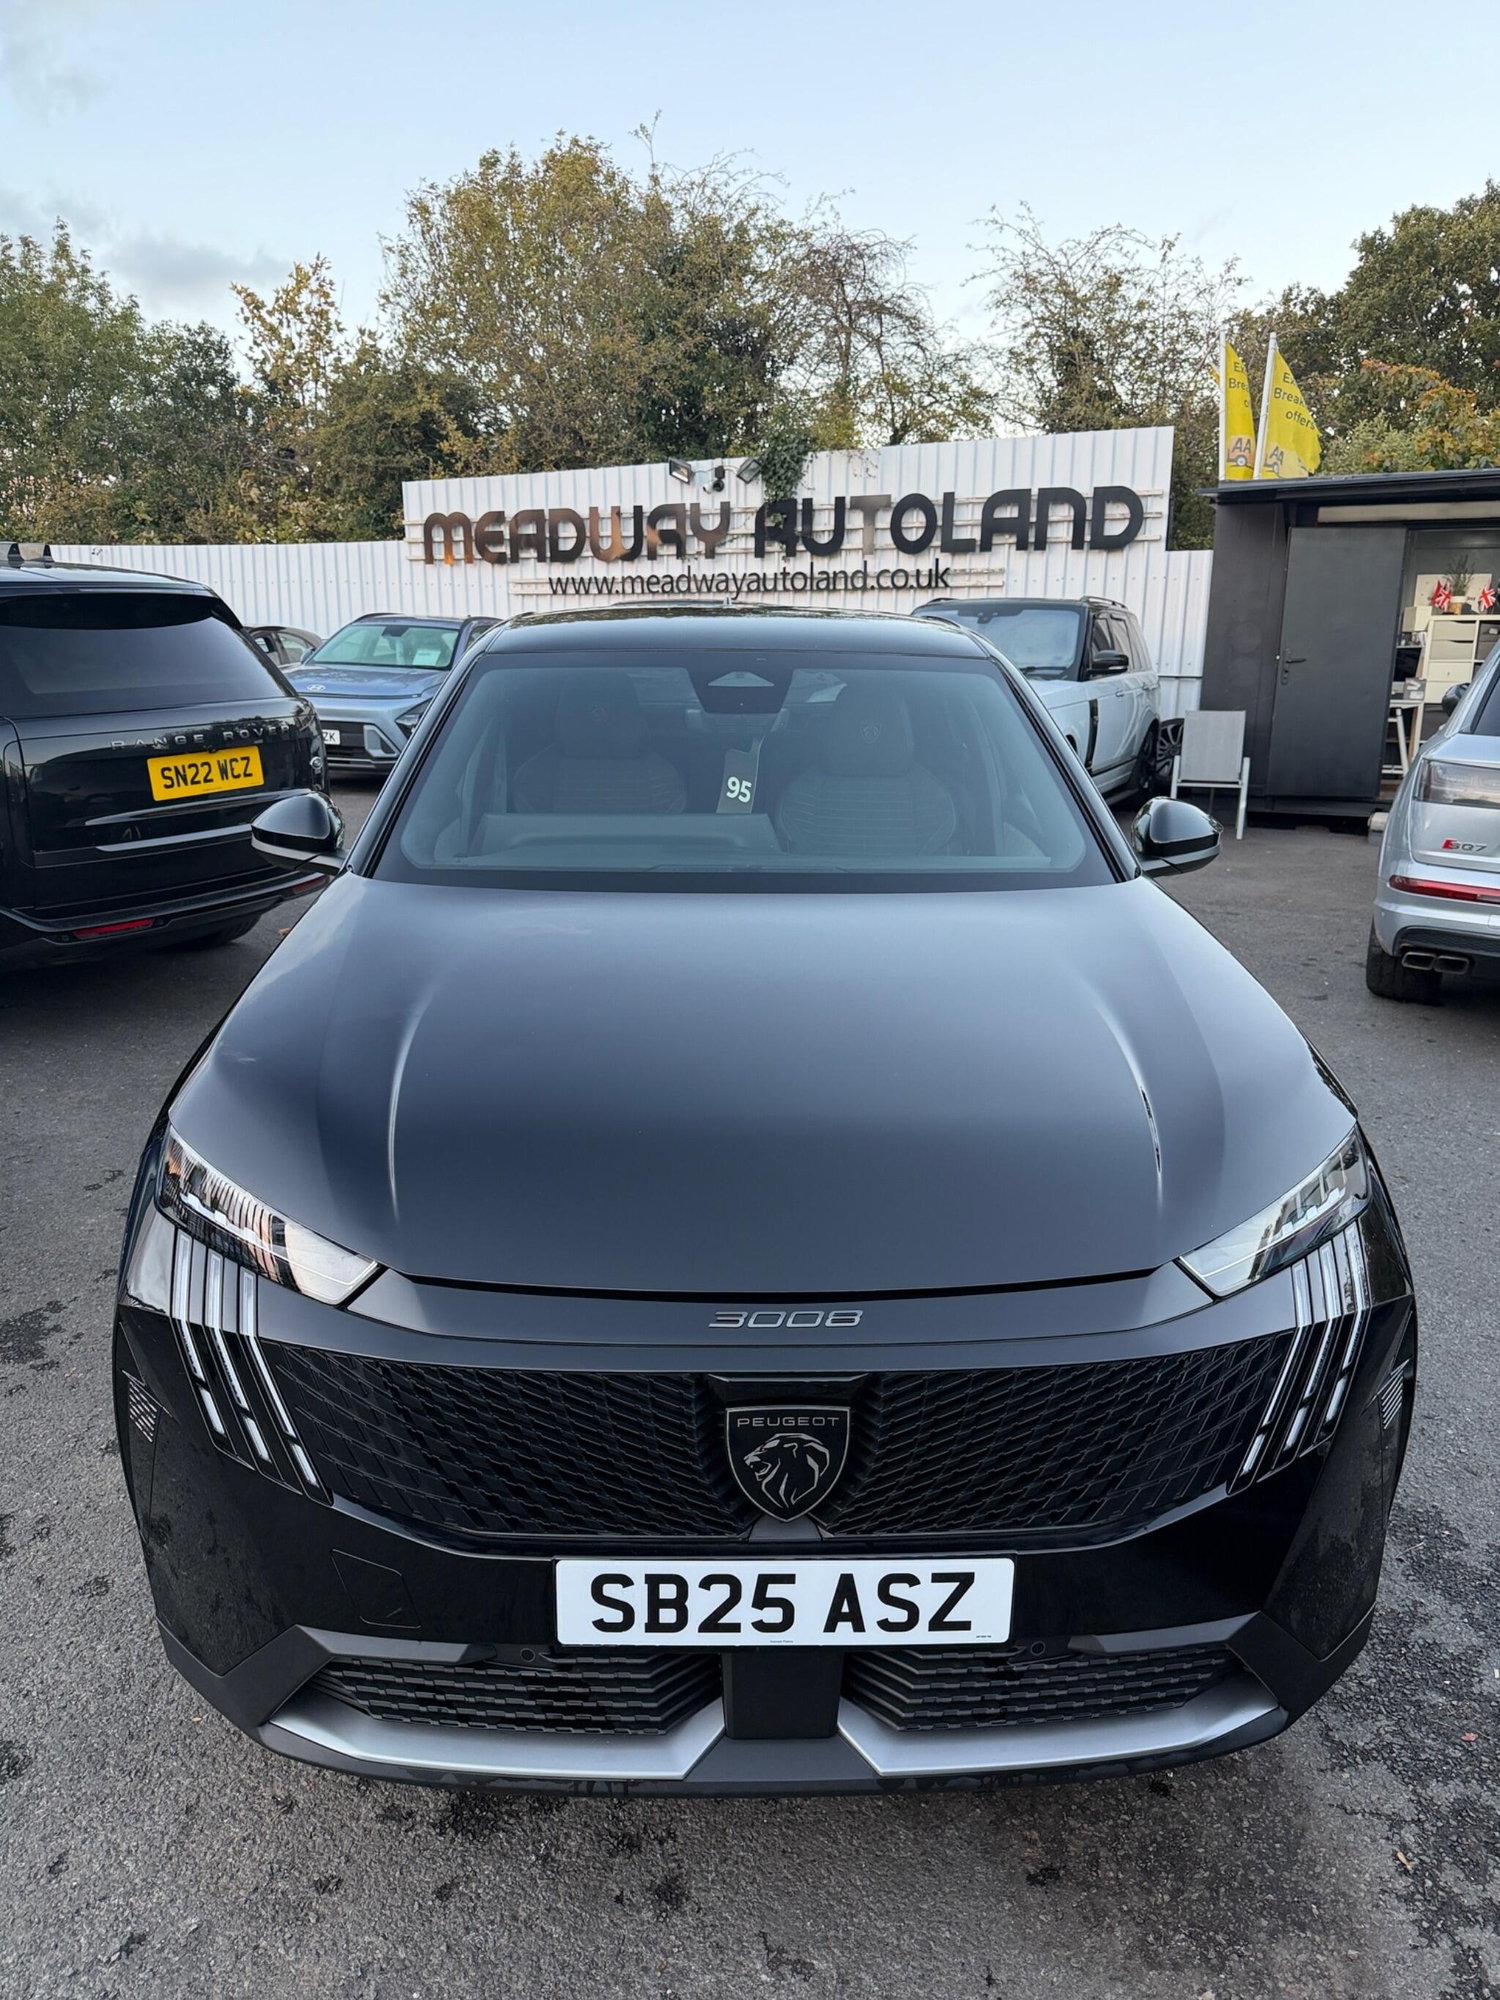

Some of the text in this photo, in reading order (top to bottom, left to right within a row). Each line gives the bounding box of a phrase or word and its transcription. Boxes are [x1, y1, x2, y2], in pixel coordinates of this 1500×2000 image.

[1285, 410, 1316, 430] offers
[1231, 437, 1252, 453] AA
[424, 485, 1144, 565] MEADWAY AUTOLAND
[549, 557, 950, 600] www.meadwayautoland.co.uk
[110, 724, 291, 750] RANGE ROVER
[160, 756, 253, 789] SN22 WCZ
[726, 776, 752, 803] 95
[708, 1310, 863, 1328] 3008
[737, 1416, 839, 1427] PEUGEOT
[590, 1571, 975, 1633] SB25 ASZ
